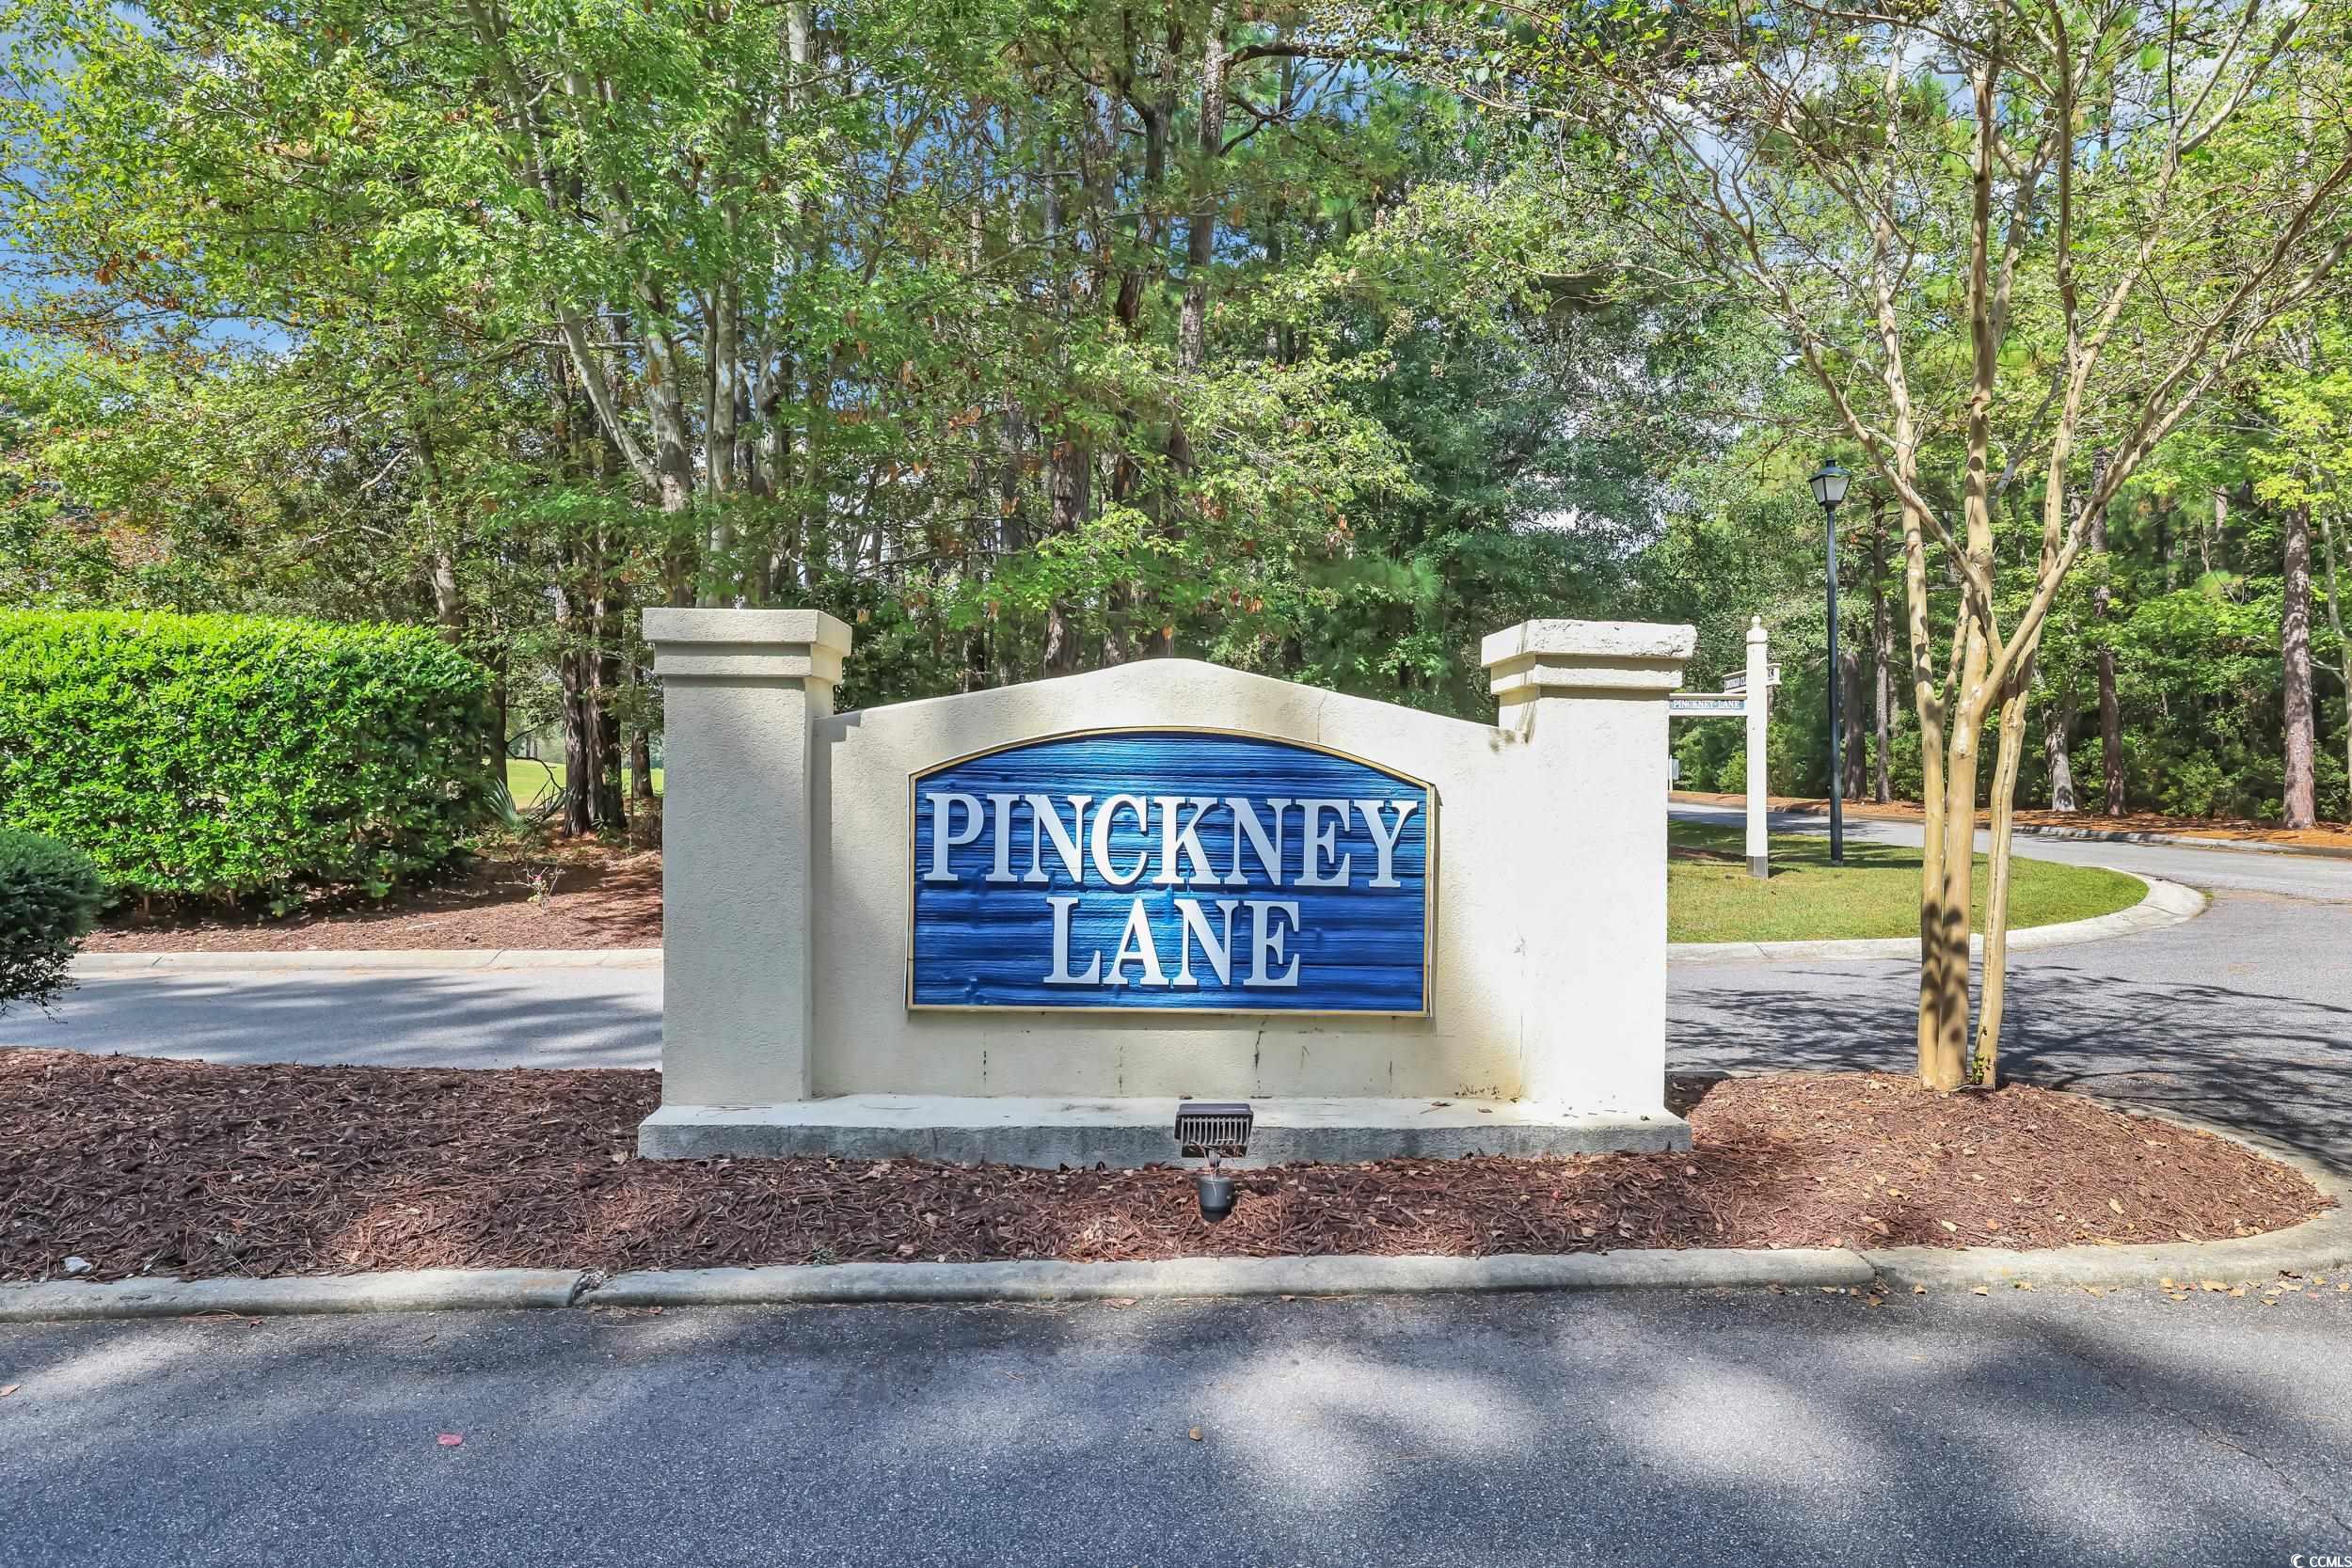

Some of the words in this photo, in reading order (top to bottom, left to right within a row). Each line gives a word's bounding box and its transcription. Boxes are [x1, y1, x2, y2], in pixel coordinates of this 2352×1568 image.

[1718, 700, 1740, 709] LANE
[923, 792, 1419, 888] PINCKNEY
[1043, 896, 1300, 988] LANE
